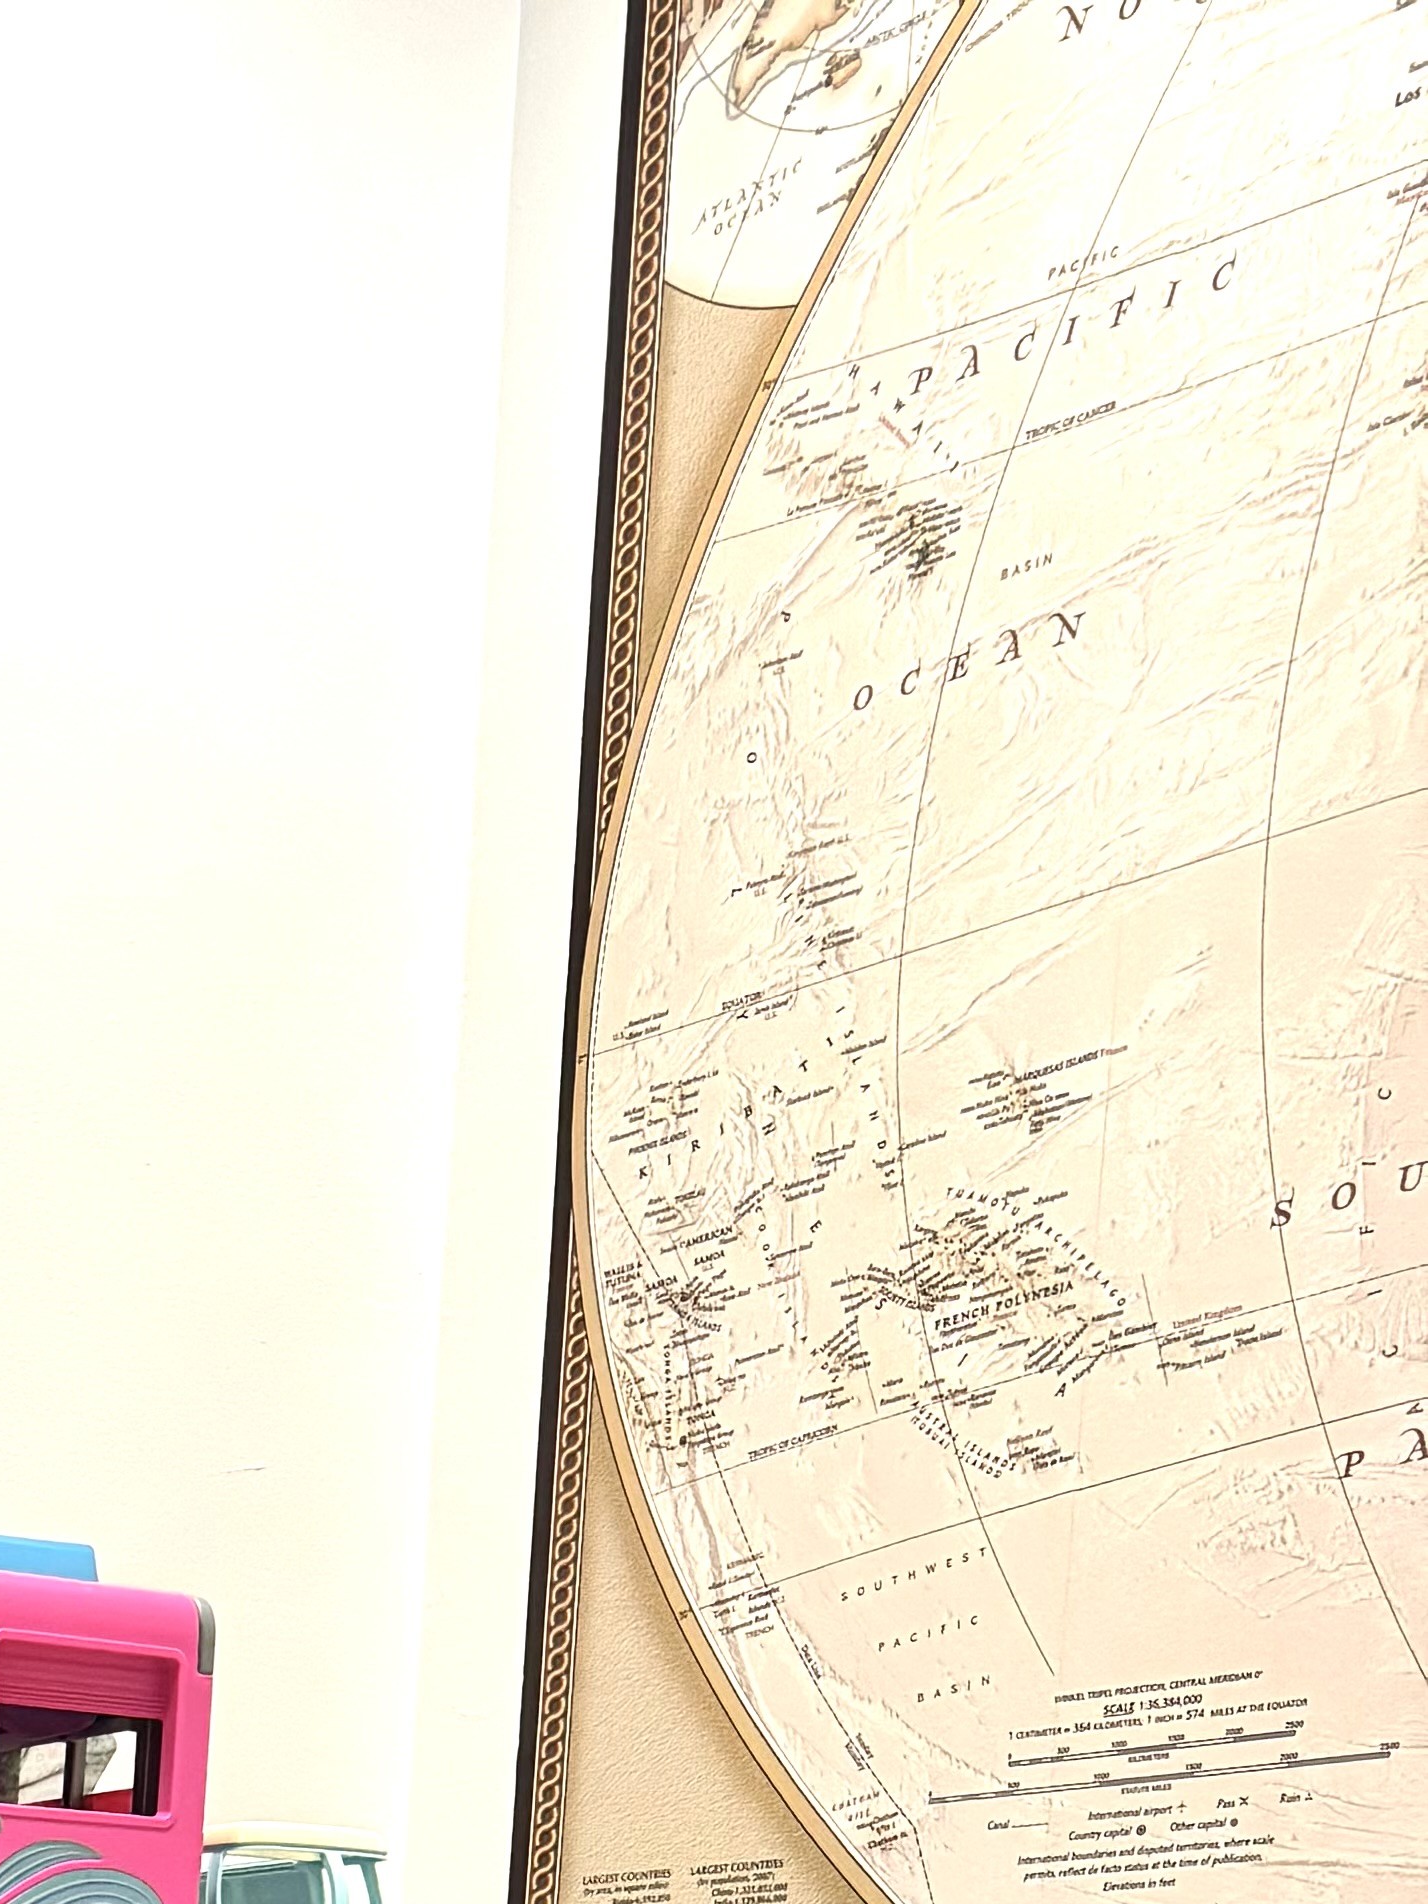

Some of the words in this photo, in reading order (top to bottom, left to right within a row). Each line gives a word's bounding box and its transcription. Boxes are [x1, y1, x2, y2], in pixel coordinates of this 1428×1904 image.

[692, 156, 802, 234] ATLANTIC
[1047, 246, 1120, 280] PACIFIC
[909, 248, 1237, 397] PACIFIC
[1026, 417, 1060, 440] TROPIC
[1076, 401, 1116, 424] CANCER
[1000, 553, 1053, 581] BASIN
[853, 612, 1086, 711] OCEAN
[935, 1305, 990, 1331] FRENCH
[995, 1282, 1074, 1312] POLYNESIA
[841, 1547, 988, 1602] SOUTHWEST
[879, 1615, 980, 1652] PACIFIC
[917, 1676, 991, 1703] BASIN
[1185, 1708, 1205, 1722] 574
[1088, 1807, 1141, 1822] International
[1143, 1804, 1173, 1818] airport
[1217, 1798, 1236, 1810] Pass
[988, 1820, 1010, 1832] Canal
[1069, 1828, 1101, 1843] Country
[1104, 1825, 1132, 1839] capital
[1170, 1819, 1196, 1832] Other
[1198, 1817, 1227, 1831] capital
[1017, 1850, 1069, 1866] International
[1072, 1847, 1117, 1862] boundaries
[1120, 1845, 1136, 1857] and
[1139, 1842, 1175, 1859] disputed
[1177, 1839, 1220, 1855] territories,
[1223, 1838, 1249, 1850] where
[1251, 1835, 1275, 1846] scale
[582, 1873, 619, 1885] LARGEST
[621, 1868, 672, 1883] COUNTRIES
[690, 1864, 728, 1877] LARGEST
[731, 1859, 784, 1874] COUNTRIES
[1024, 1866, 1055, 1882] permits,
[1058, 1864, 1086, 1877] reflect
[1101, 1861, 1122, 1874] facto
[1124, 1859, 1149, 1871] status
[1179, 1855, 1198, 1867] time
[1103, 1877, 1146, 1892] Elevations
[1159, 1877, 1176, 1888] feet
